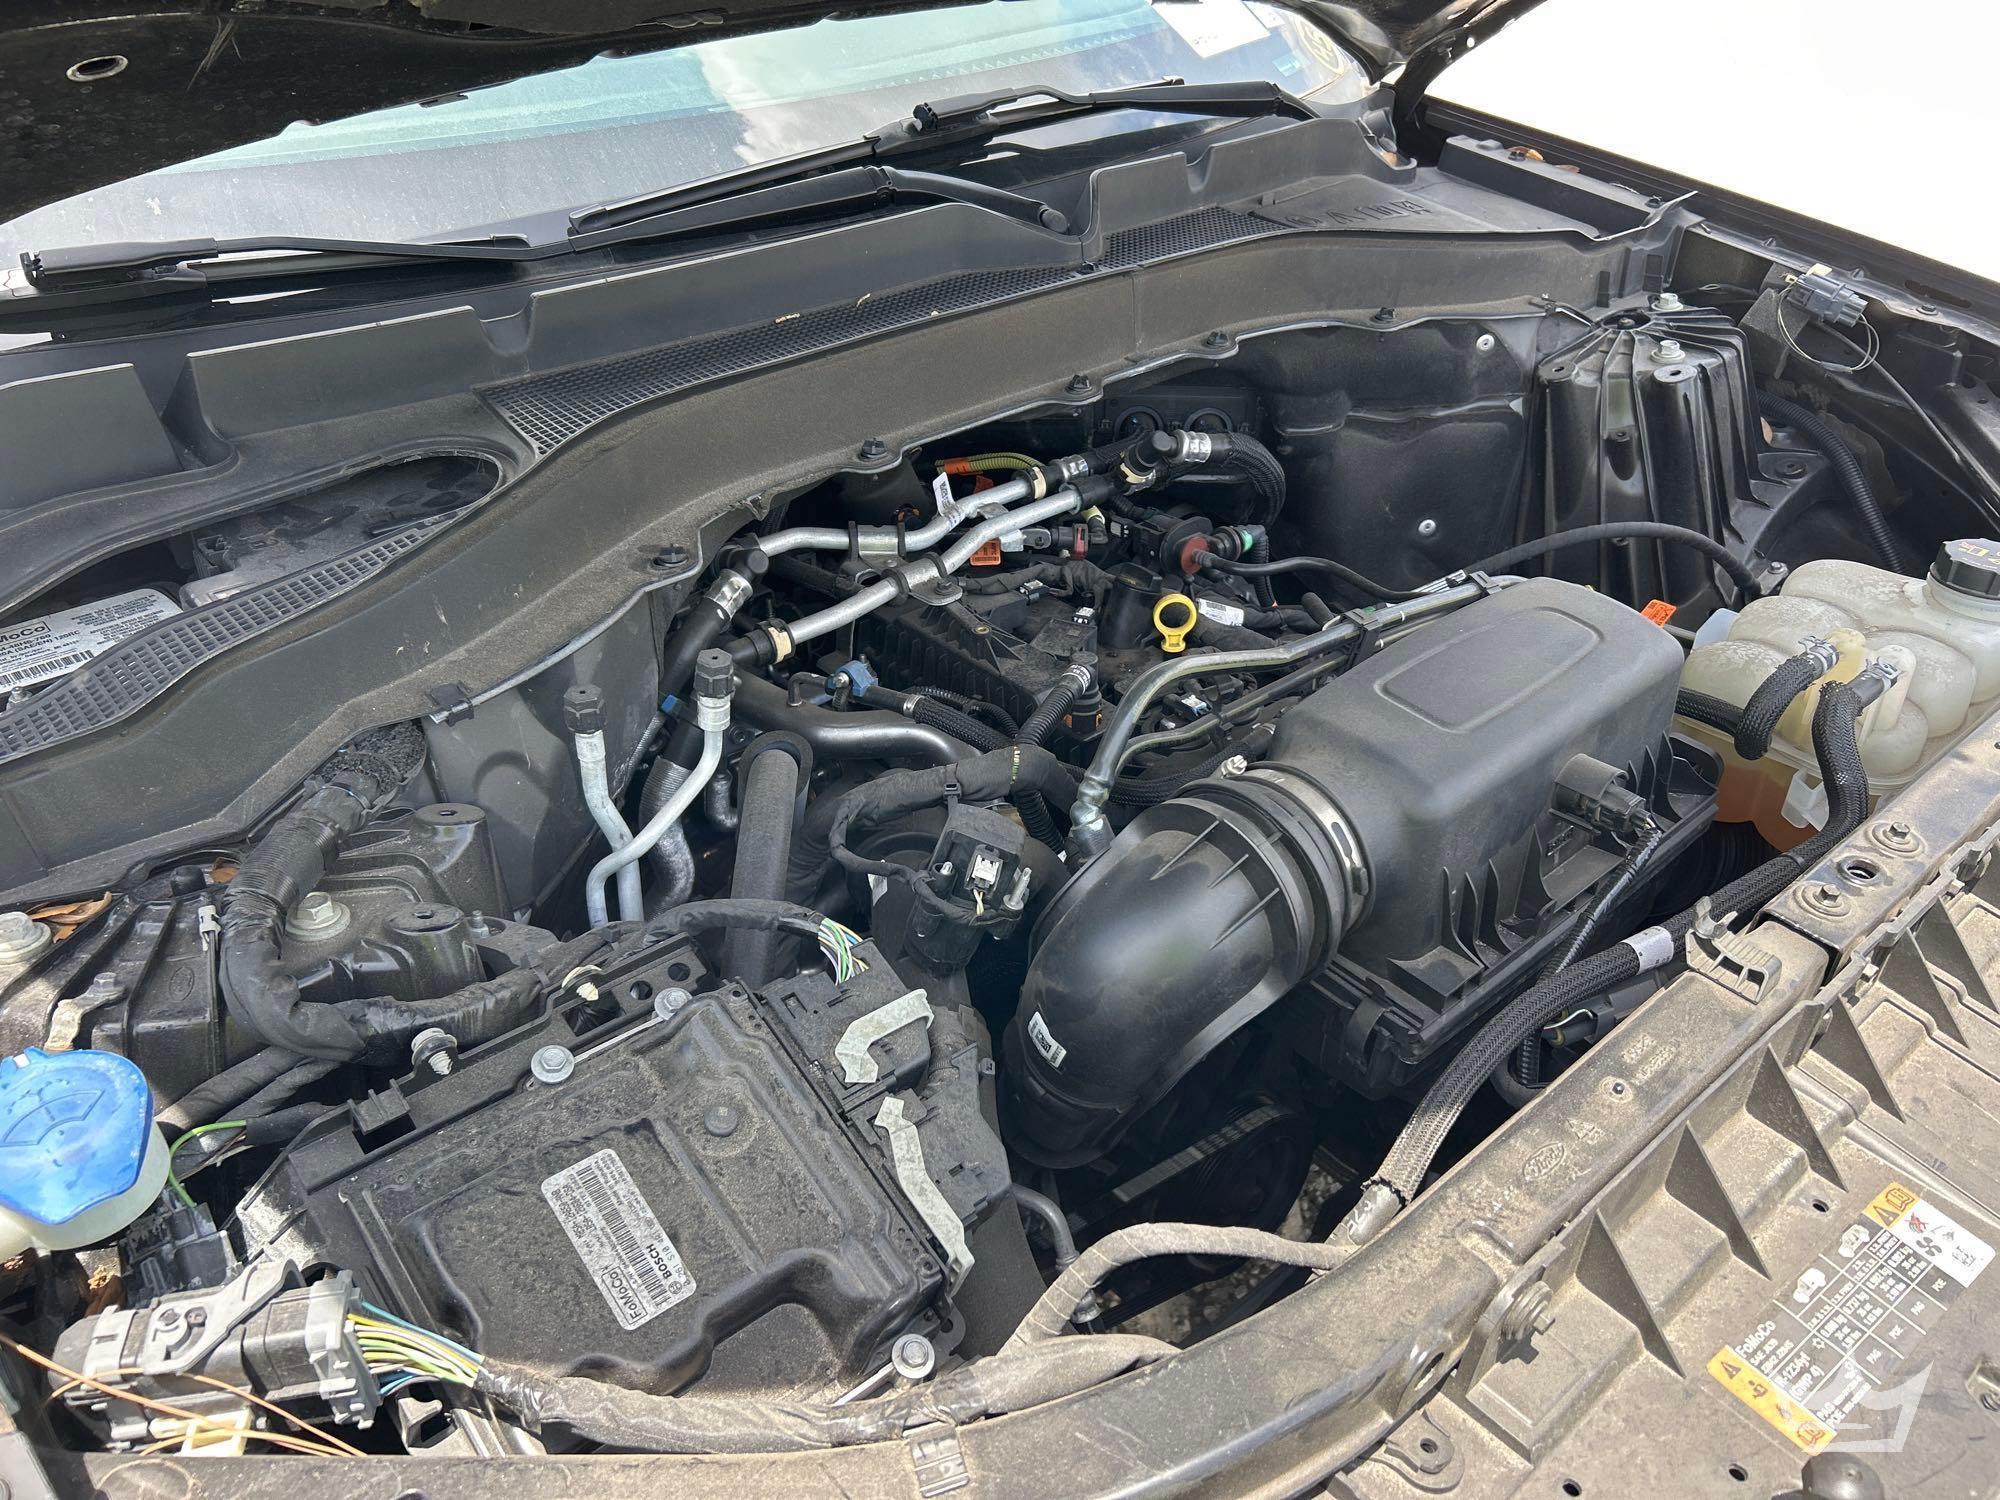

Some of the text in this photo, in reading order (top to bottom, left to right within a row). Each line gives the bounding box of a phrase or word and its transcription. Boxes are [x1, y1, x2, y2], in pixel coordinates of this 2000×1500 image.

[645, 1243, 672, 1279] BOSCH
[672, 1262, 685, 1278] 261
[1877, 1265, 1893, 1278] kg
[1931, 1277, 1947, 1292] POE
[606, 1269, 642, 1320] FoMoCo
[1909, 1300, 1926, 1315] PAG
[1734, 1317, 1778, 1358] FoMoCo
[1749, 1349, 1767, 1366] SAE
[1865, 1347, 1883, 1364] PAG
[1773, 1350, 1813, 1389] R-1234yf
[1787, 1372, 1817, 1400] (GWP
[1825, 1408, 1846, 1428] POE
